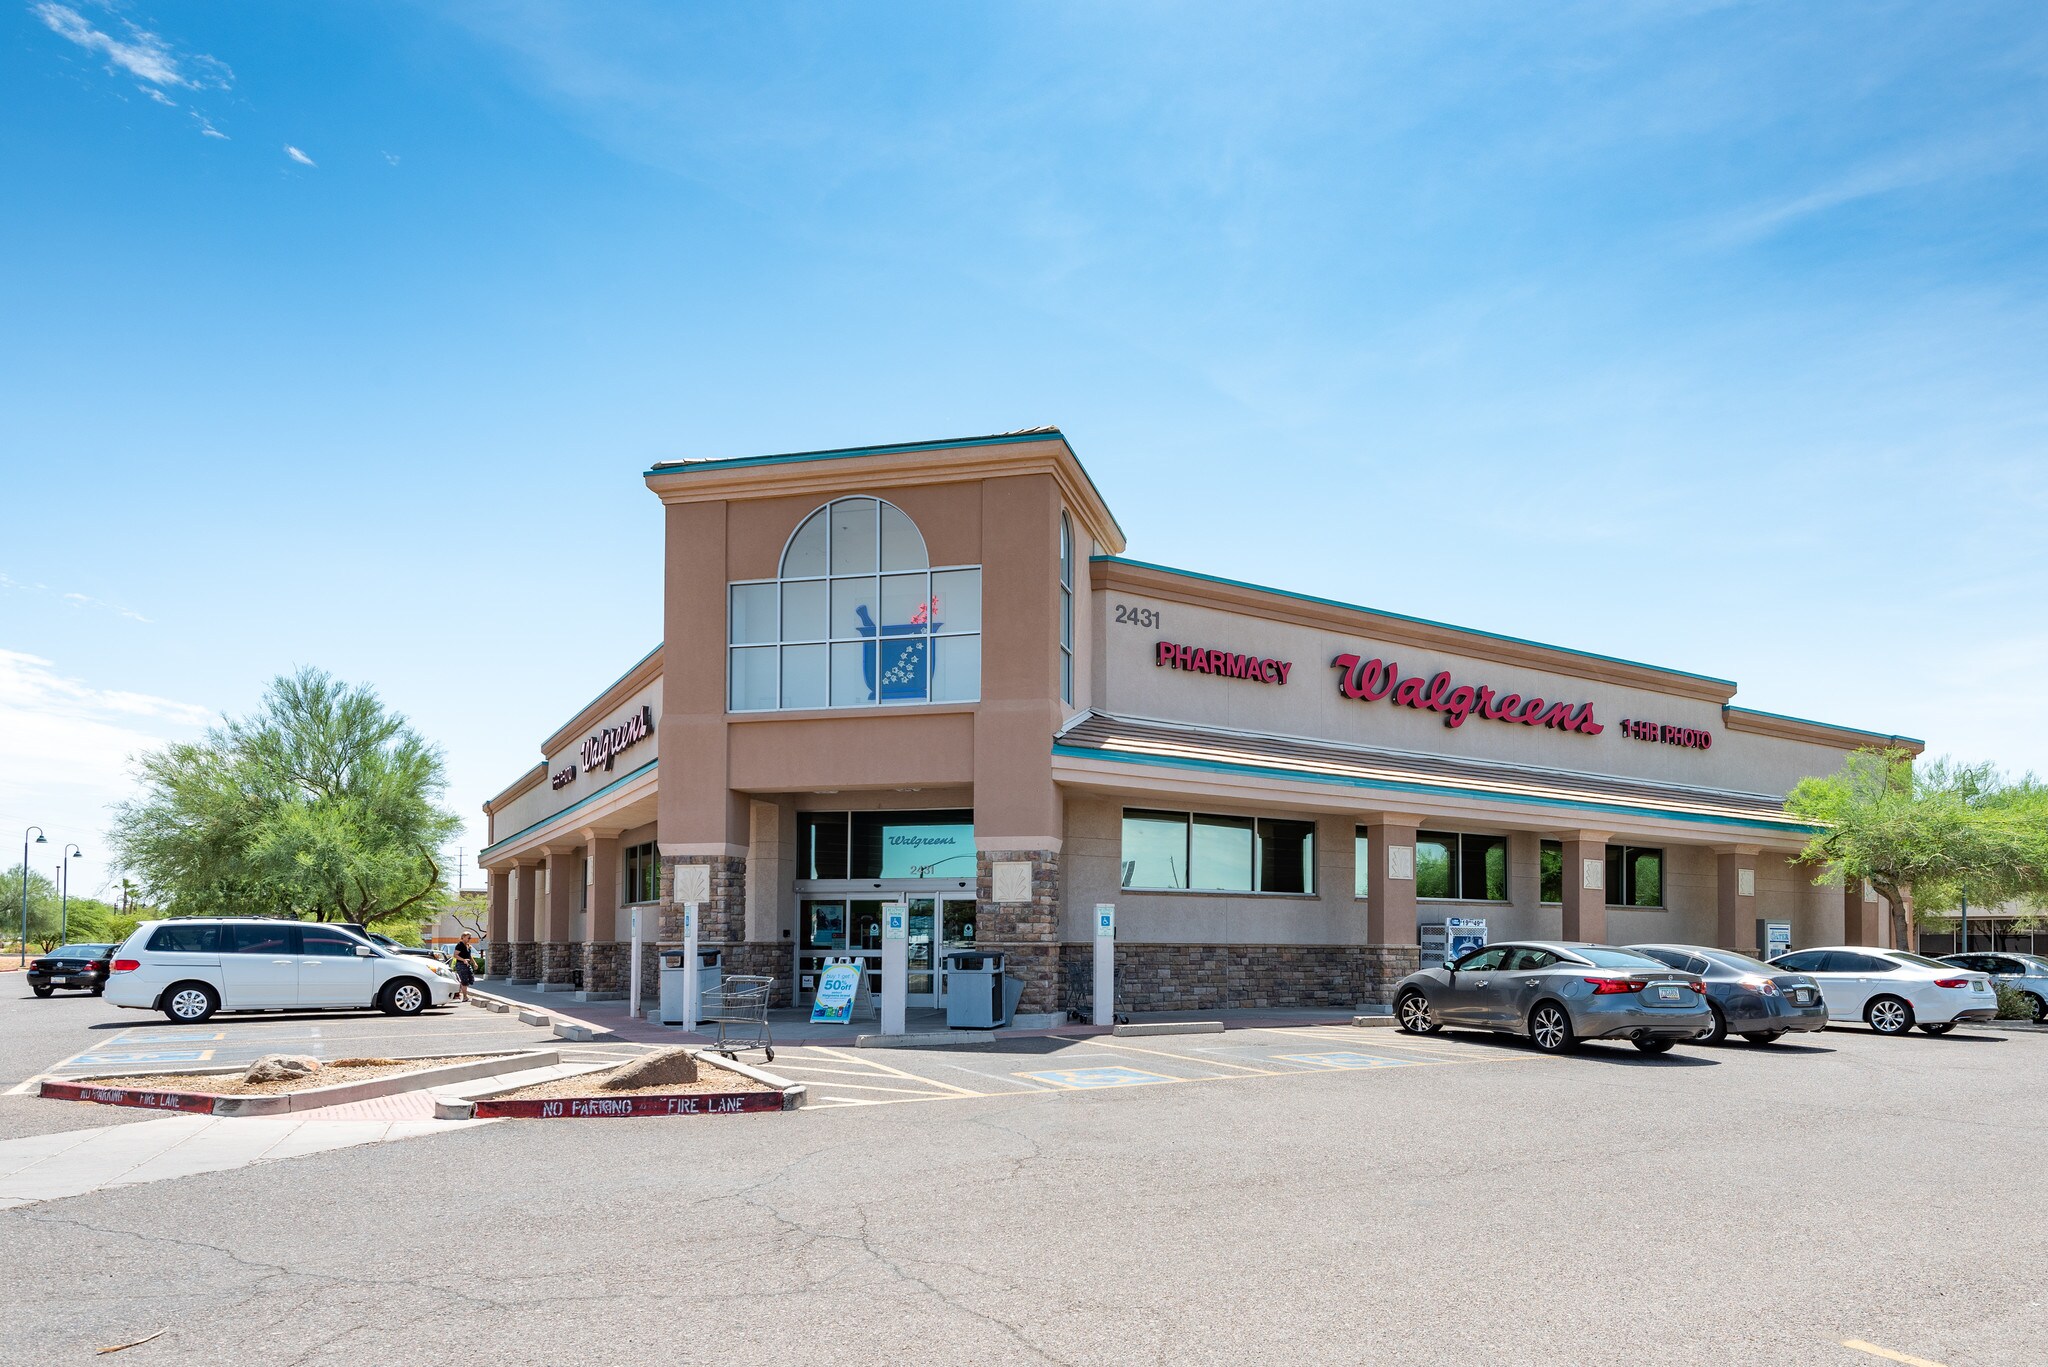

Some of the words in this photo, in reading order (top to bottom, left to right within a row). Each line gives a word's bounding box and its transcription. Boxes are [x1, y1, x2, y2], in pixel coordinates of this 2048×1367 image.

[1115, 604, 1160, 629] 2431
[1156, 641, 1293, 686] PHARMACY
[1331, 653, 1605, 735] Walgreens
[581, 706, 650, 773] Walgreens
[1620, 719, 1660, 742] 1-HR
[1661, 725, 1713, 750] PHOTO
[888, 836, 957, 848] Walgreens
[910, 865, 935, 875] 2431
[140, 1094, 156, 1106] FIRE
[160, 1093, 180, 1108] LANE
[543, 1102, 563, 1117] NO
[667, 1098, 699, 1114] FIRE
[708, 1097, 745, 1113] LANE
